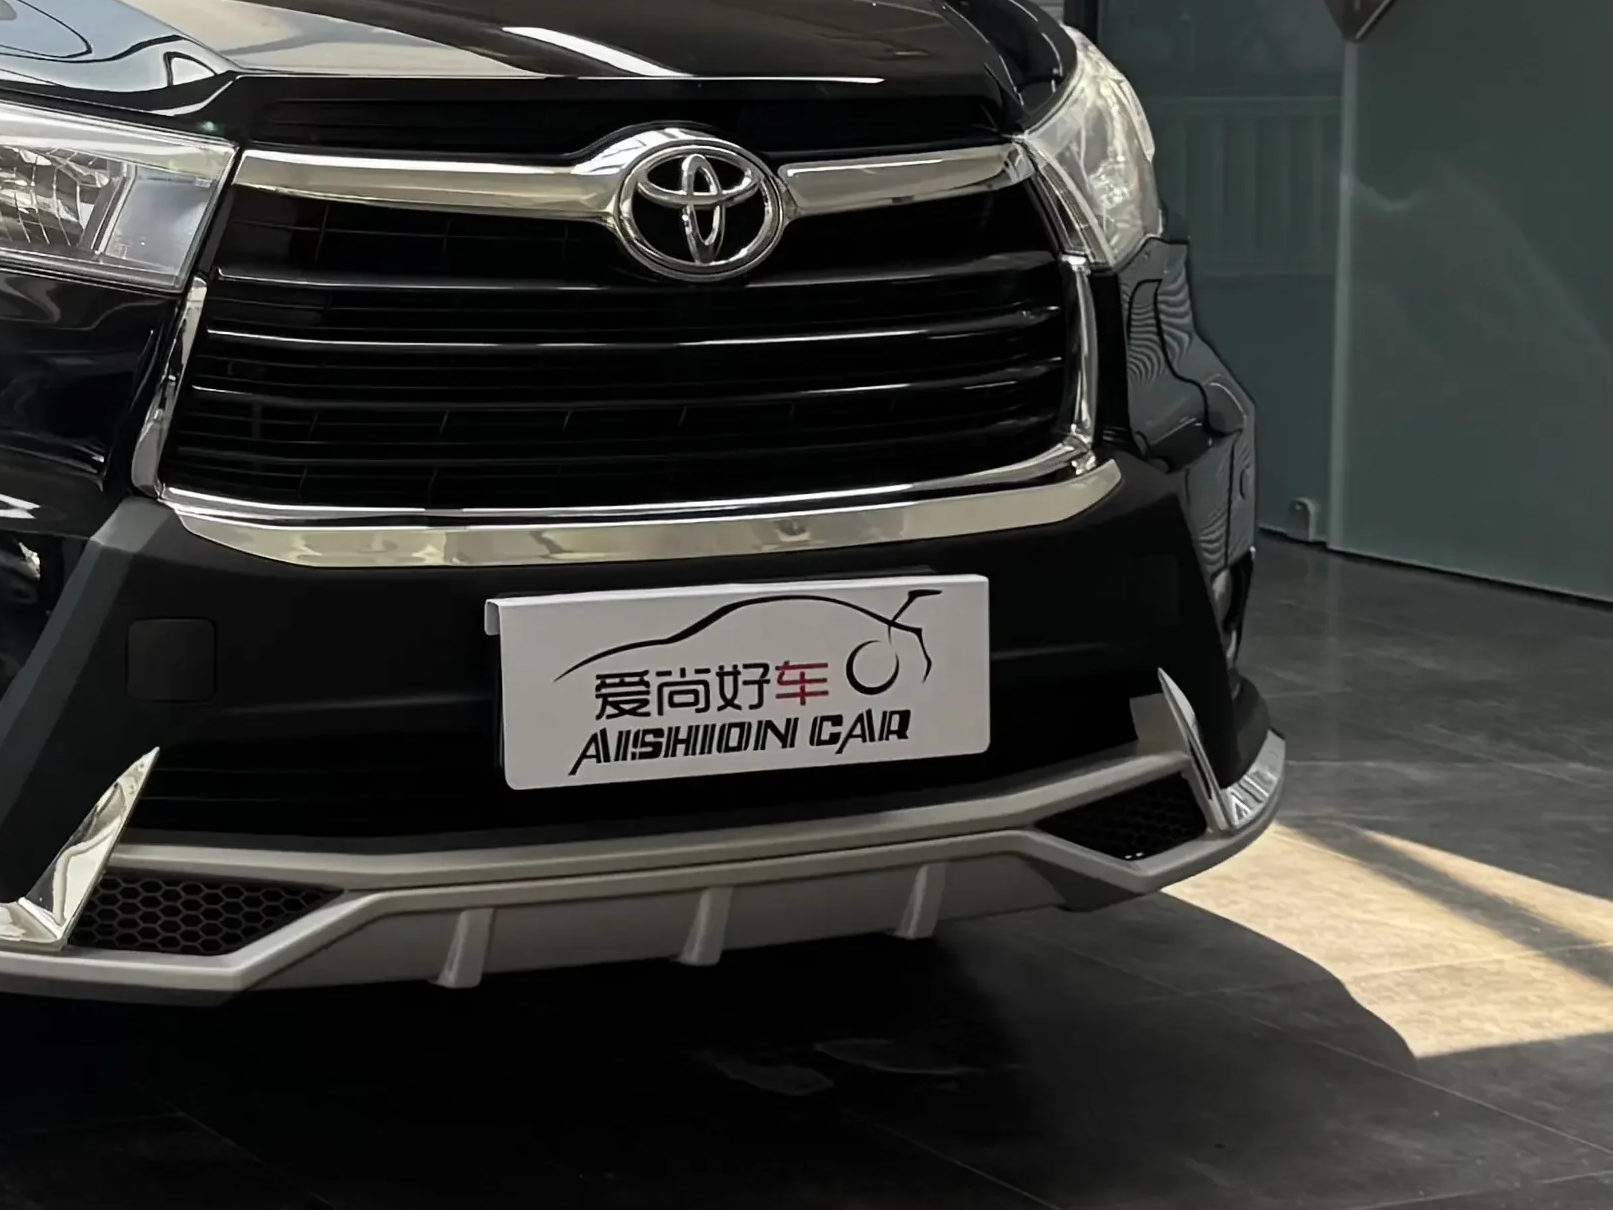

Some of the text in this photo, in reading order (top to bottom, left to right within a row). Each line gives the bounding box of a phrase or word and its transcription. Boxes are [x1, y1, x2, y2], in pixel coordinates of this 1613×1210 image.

[594, 659, 829, 721] 爱尚好车
[568, 708, 911, 777] AISHION CAR
